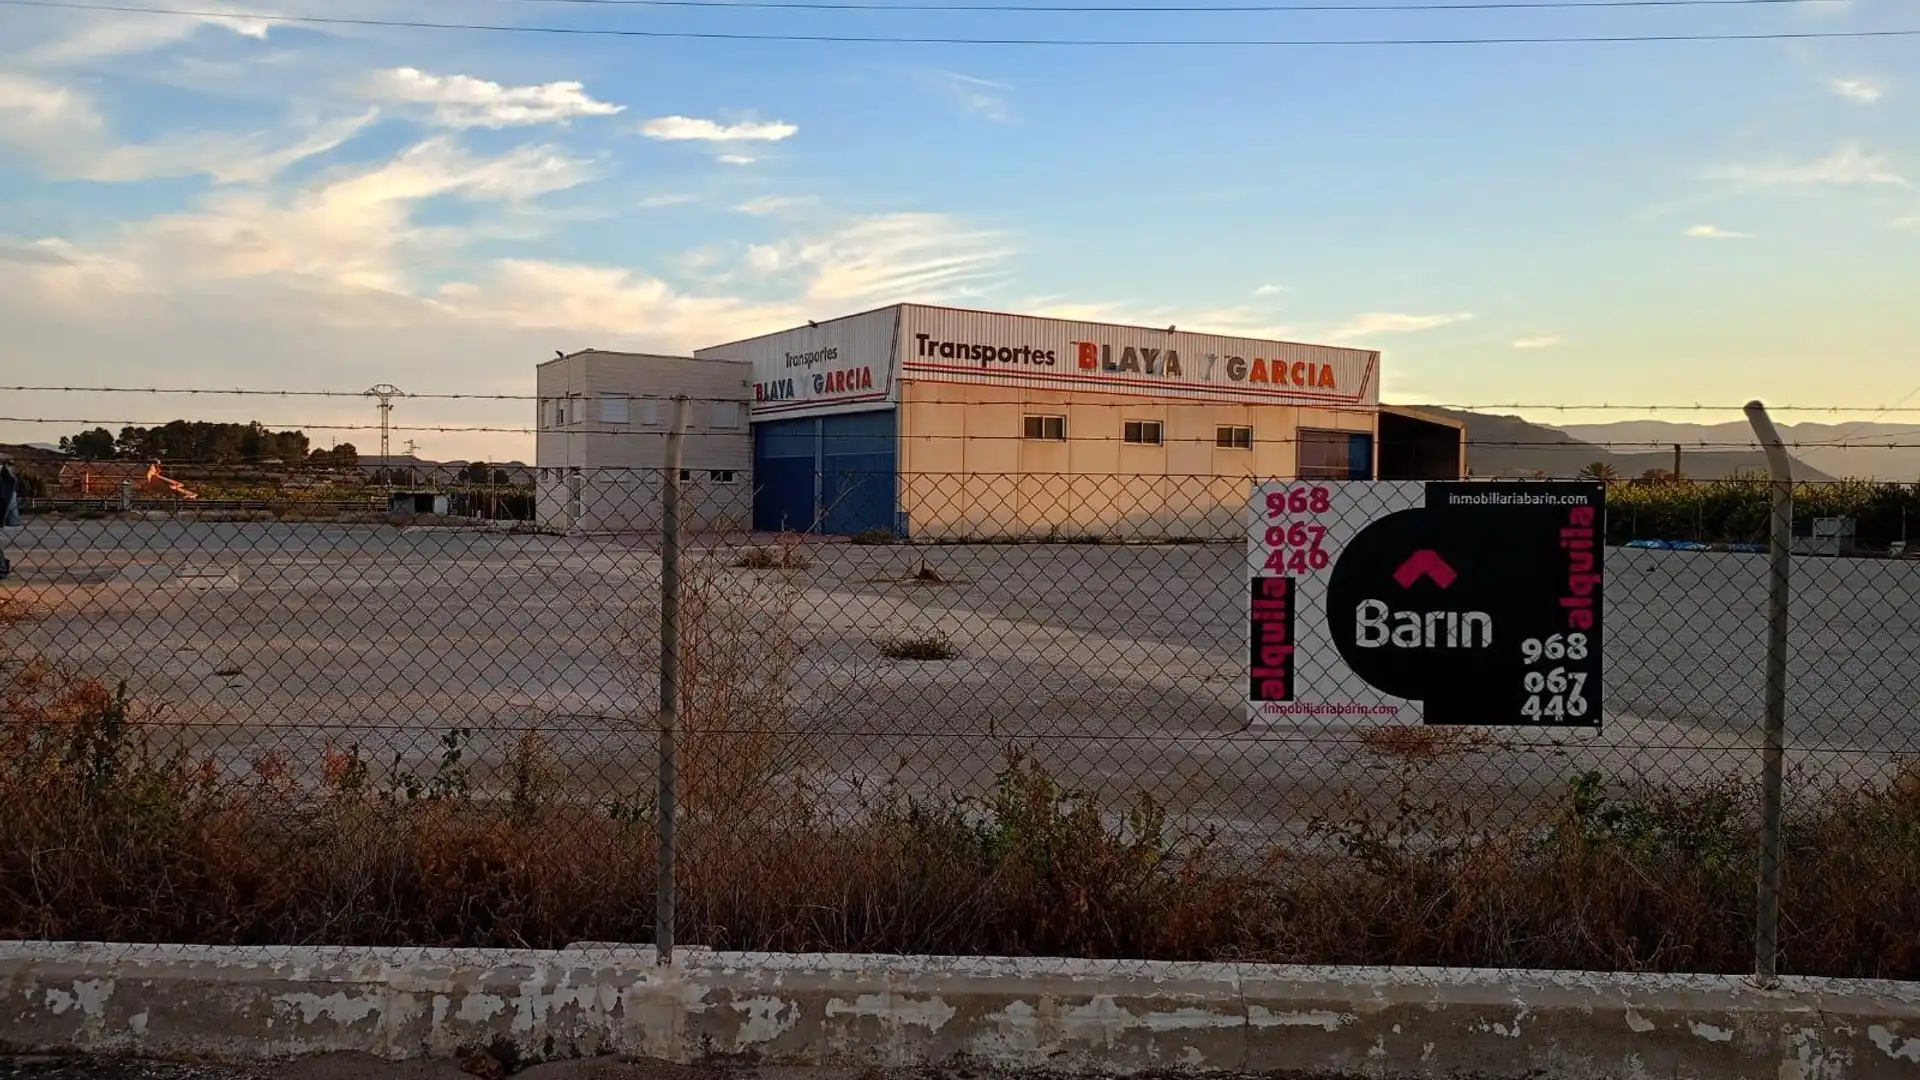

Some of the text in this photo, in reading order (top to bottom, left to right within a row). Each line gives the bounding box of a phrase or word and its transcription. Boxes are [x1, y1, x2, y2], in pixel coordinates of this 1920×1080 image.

[785, 346, 838, 369] Transportes
[916, 333, 1056, 367] Transportes
[1070, 340, 1182, 378] BLAYA
[1225, 355, 1336, 389] GARCIA
[753, 378, 795, 404] BLAYA
[812, 366, 873, 394] GARCIA
[1265, 487, 1330, 519] 968
[1449, 492, 1588, 505] inmobiliariabarin.com
[1264, 521, 1328, 550] 067
[1264, 549, 1329, 574] 440
[1559, 505, 1601, 630] alquila
[1252, 576, 1295, 700] alquila
[1355, 598, 1493, 648] Barin
[1520, 632, 1588, 665] 968
[1523, 666, 1588, 699] 067
[1264, 702, 1398, 715] inmobiliariabarin.com
[1520, 694, 1588, 722] 440
